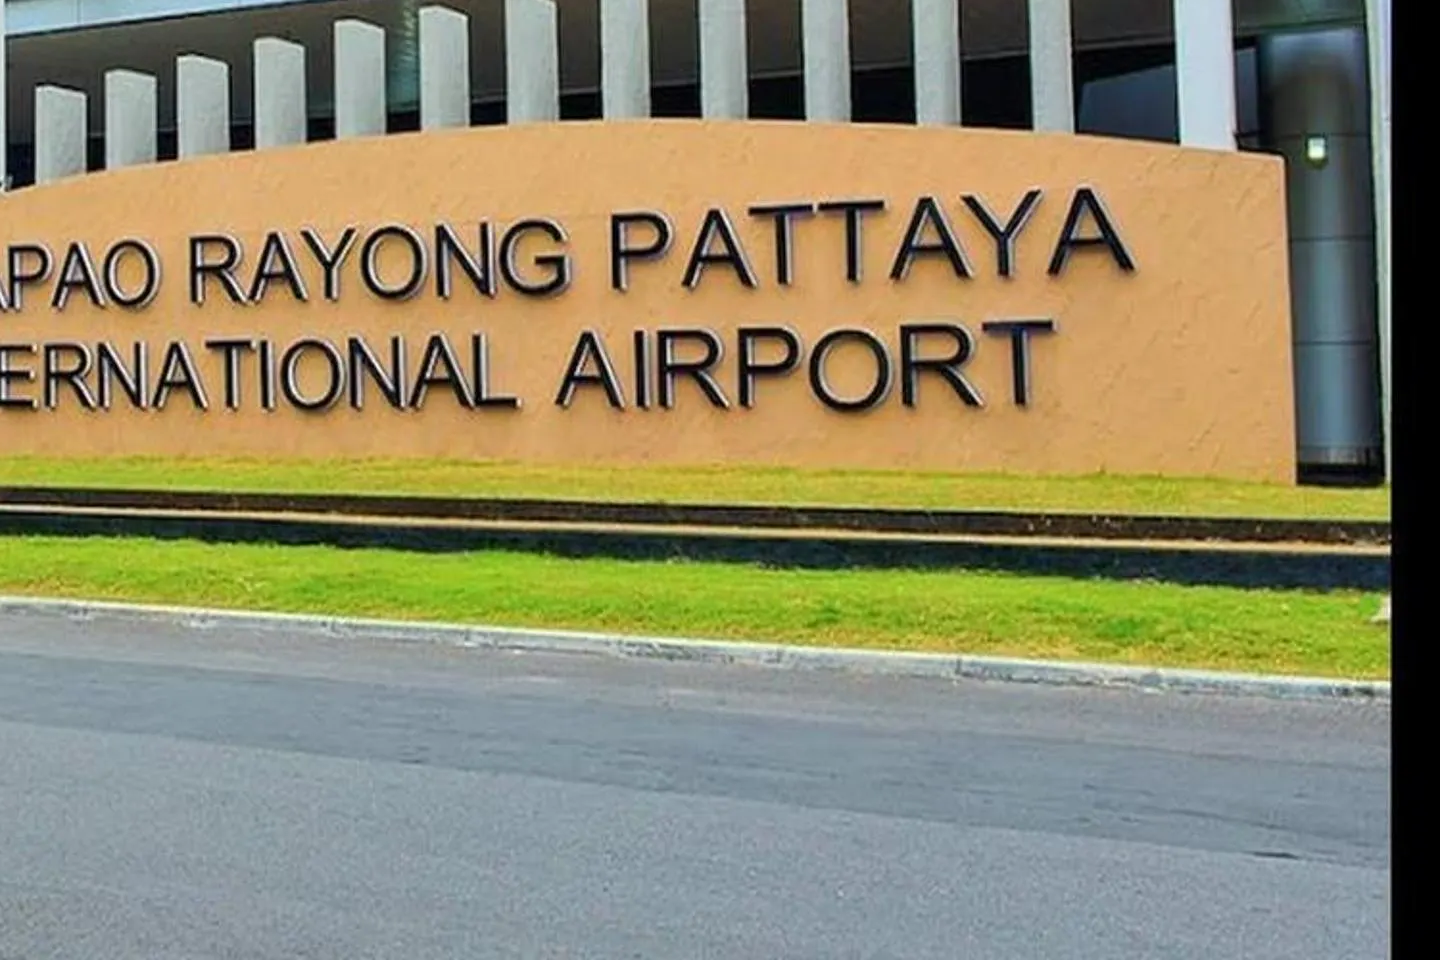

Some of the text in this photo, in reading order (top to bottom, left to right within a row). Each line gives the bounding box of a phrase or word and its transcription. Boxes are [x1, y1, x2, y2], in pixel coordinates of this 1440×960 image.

[189, 220, 572, 307] RAYONG
[610, 184, 1137, 291] PATTAYA
[555, 318, 1055, 414] AIRPORT
